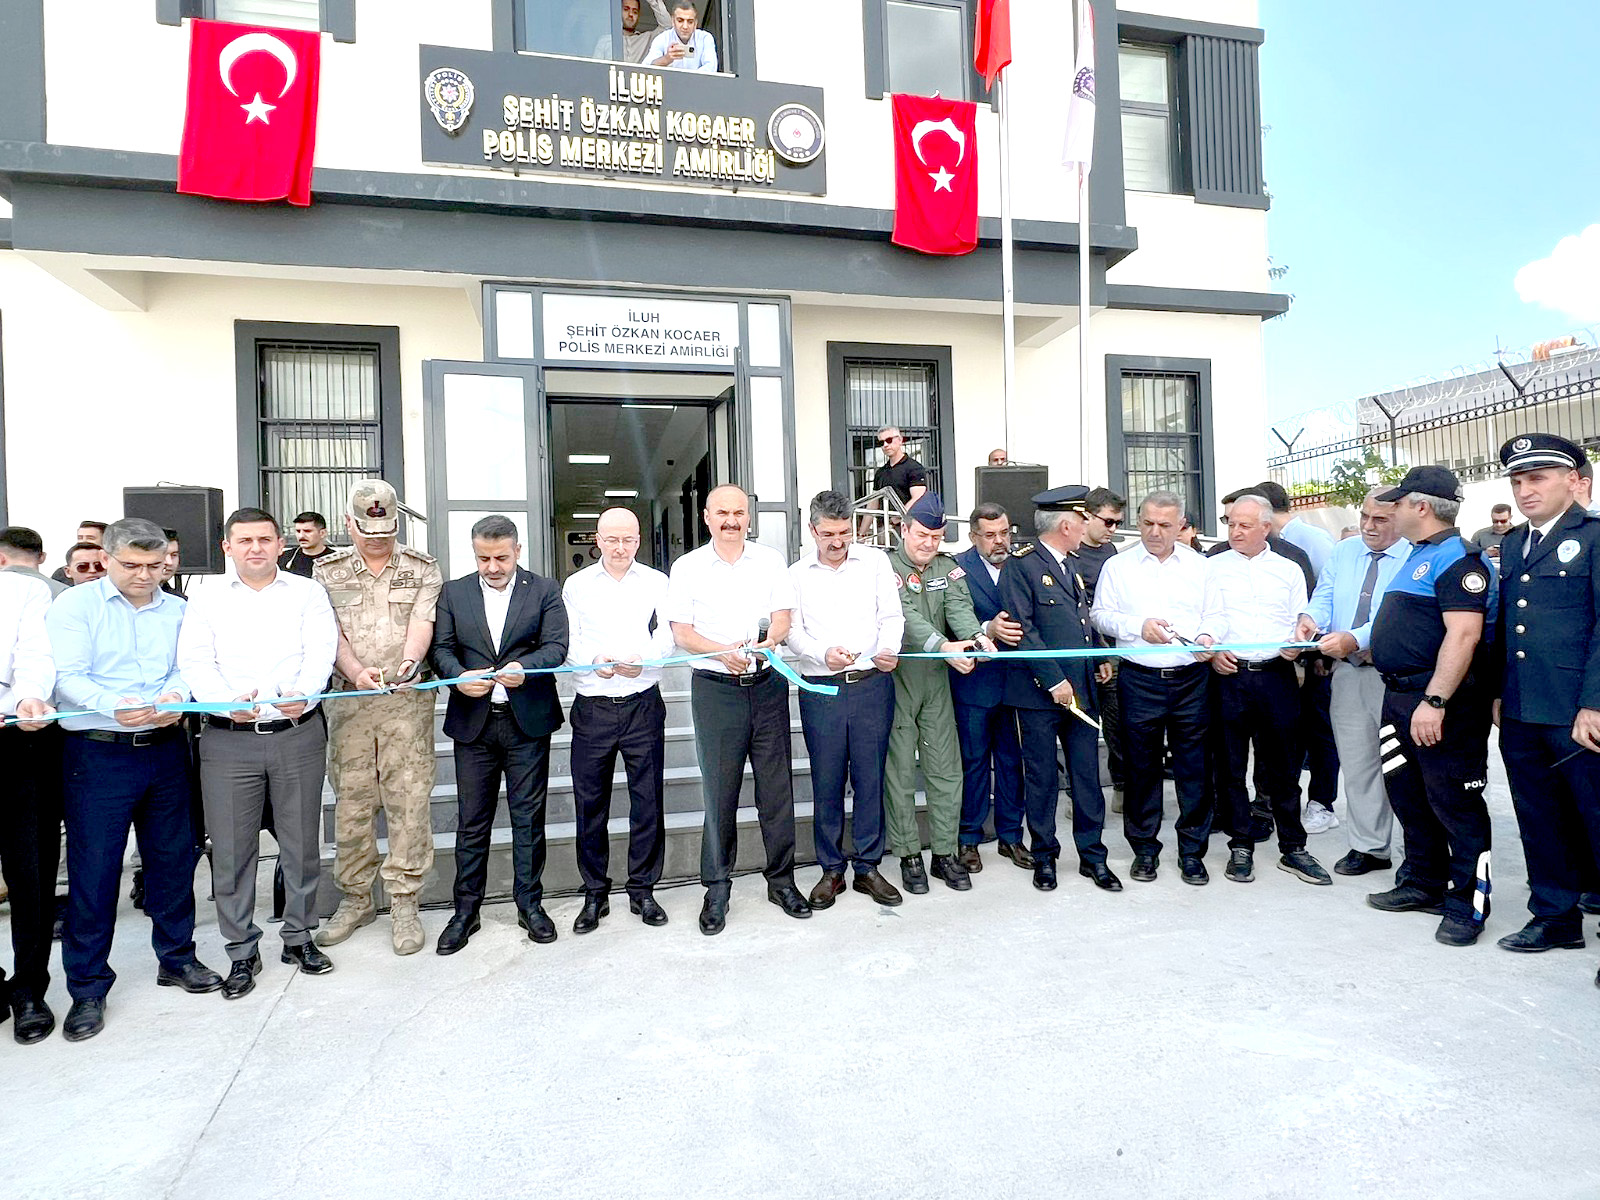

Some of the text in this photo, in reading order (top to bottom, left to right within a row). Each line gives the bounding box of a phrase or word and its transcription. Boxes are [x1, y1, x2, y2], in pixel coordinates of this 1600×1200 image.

[609, 66, 663, 105] İLUH
[503, 93, 574, 131] ŞEHİT
[580, 96, 660, 139] ÖZKAN
[666, 110, 756, 148] KOCAER
[482, 128, 775, 183] POLİS MERKEZİ AMİRLİĞİ
[628, 308, 660, 323] İLUH
[566, 323, 720, 342] ŞEHİT ÖZKAN KOCAER
[559, 340, 729, 358] POLİS MERKEZİ AMİRLİĞİ
